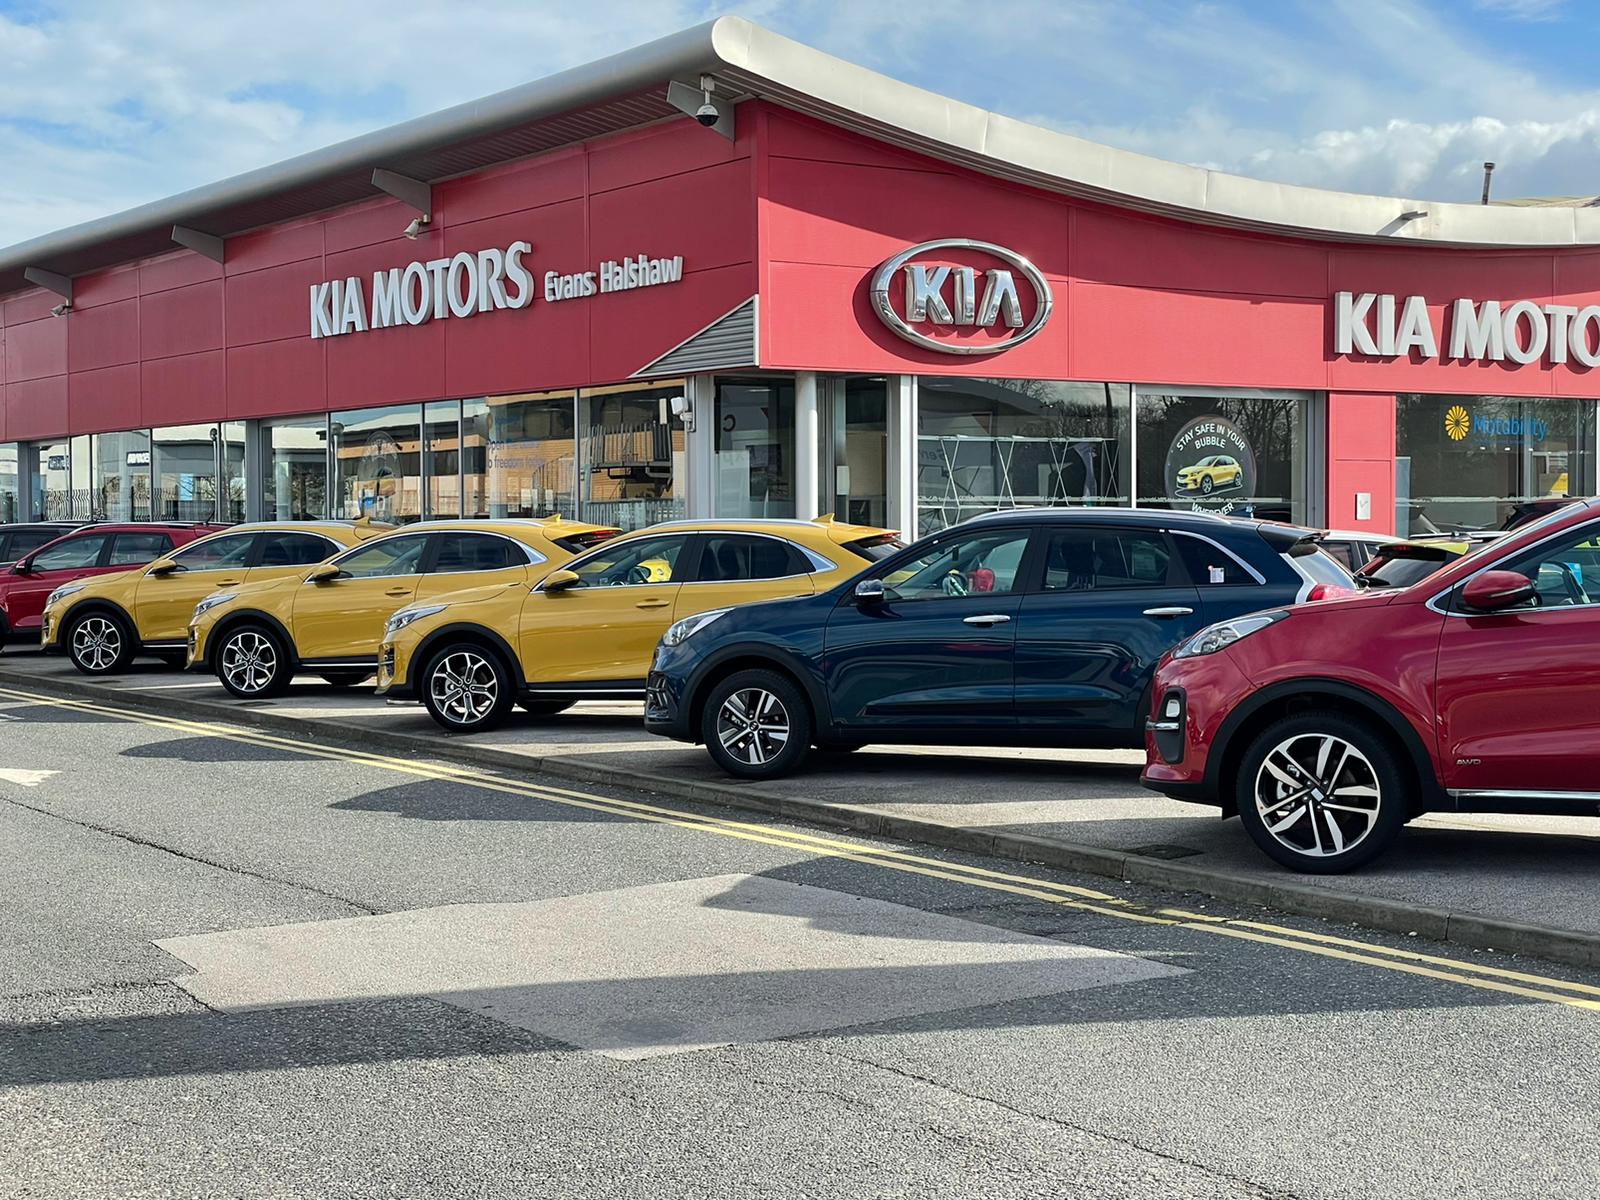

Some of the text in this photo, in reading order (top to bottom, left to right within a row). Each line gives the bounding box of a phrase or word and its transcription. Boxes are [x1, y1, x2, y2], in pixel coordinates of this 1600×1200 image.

[310, 240, 535, 339] KIA MOTORS
[544, 254, 683, 302] Evans Halshaw
[904, 264, 1024, 327] KIA
[1335, 291, 1600, 368] KIA MOTO
[1176, 423, 1246, 451] STAY SAFE IN YOUR
[1194, 436, 1226, 449] BUBBLE
[1473, 414, 1547, 441] Motability
